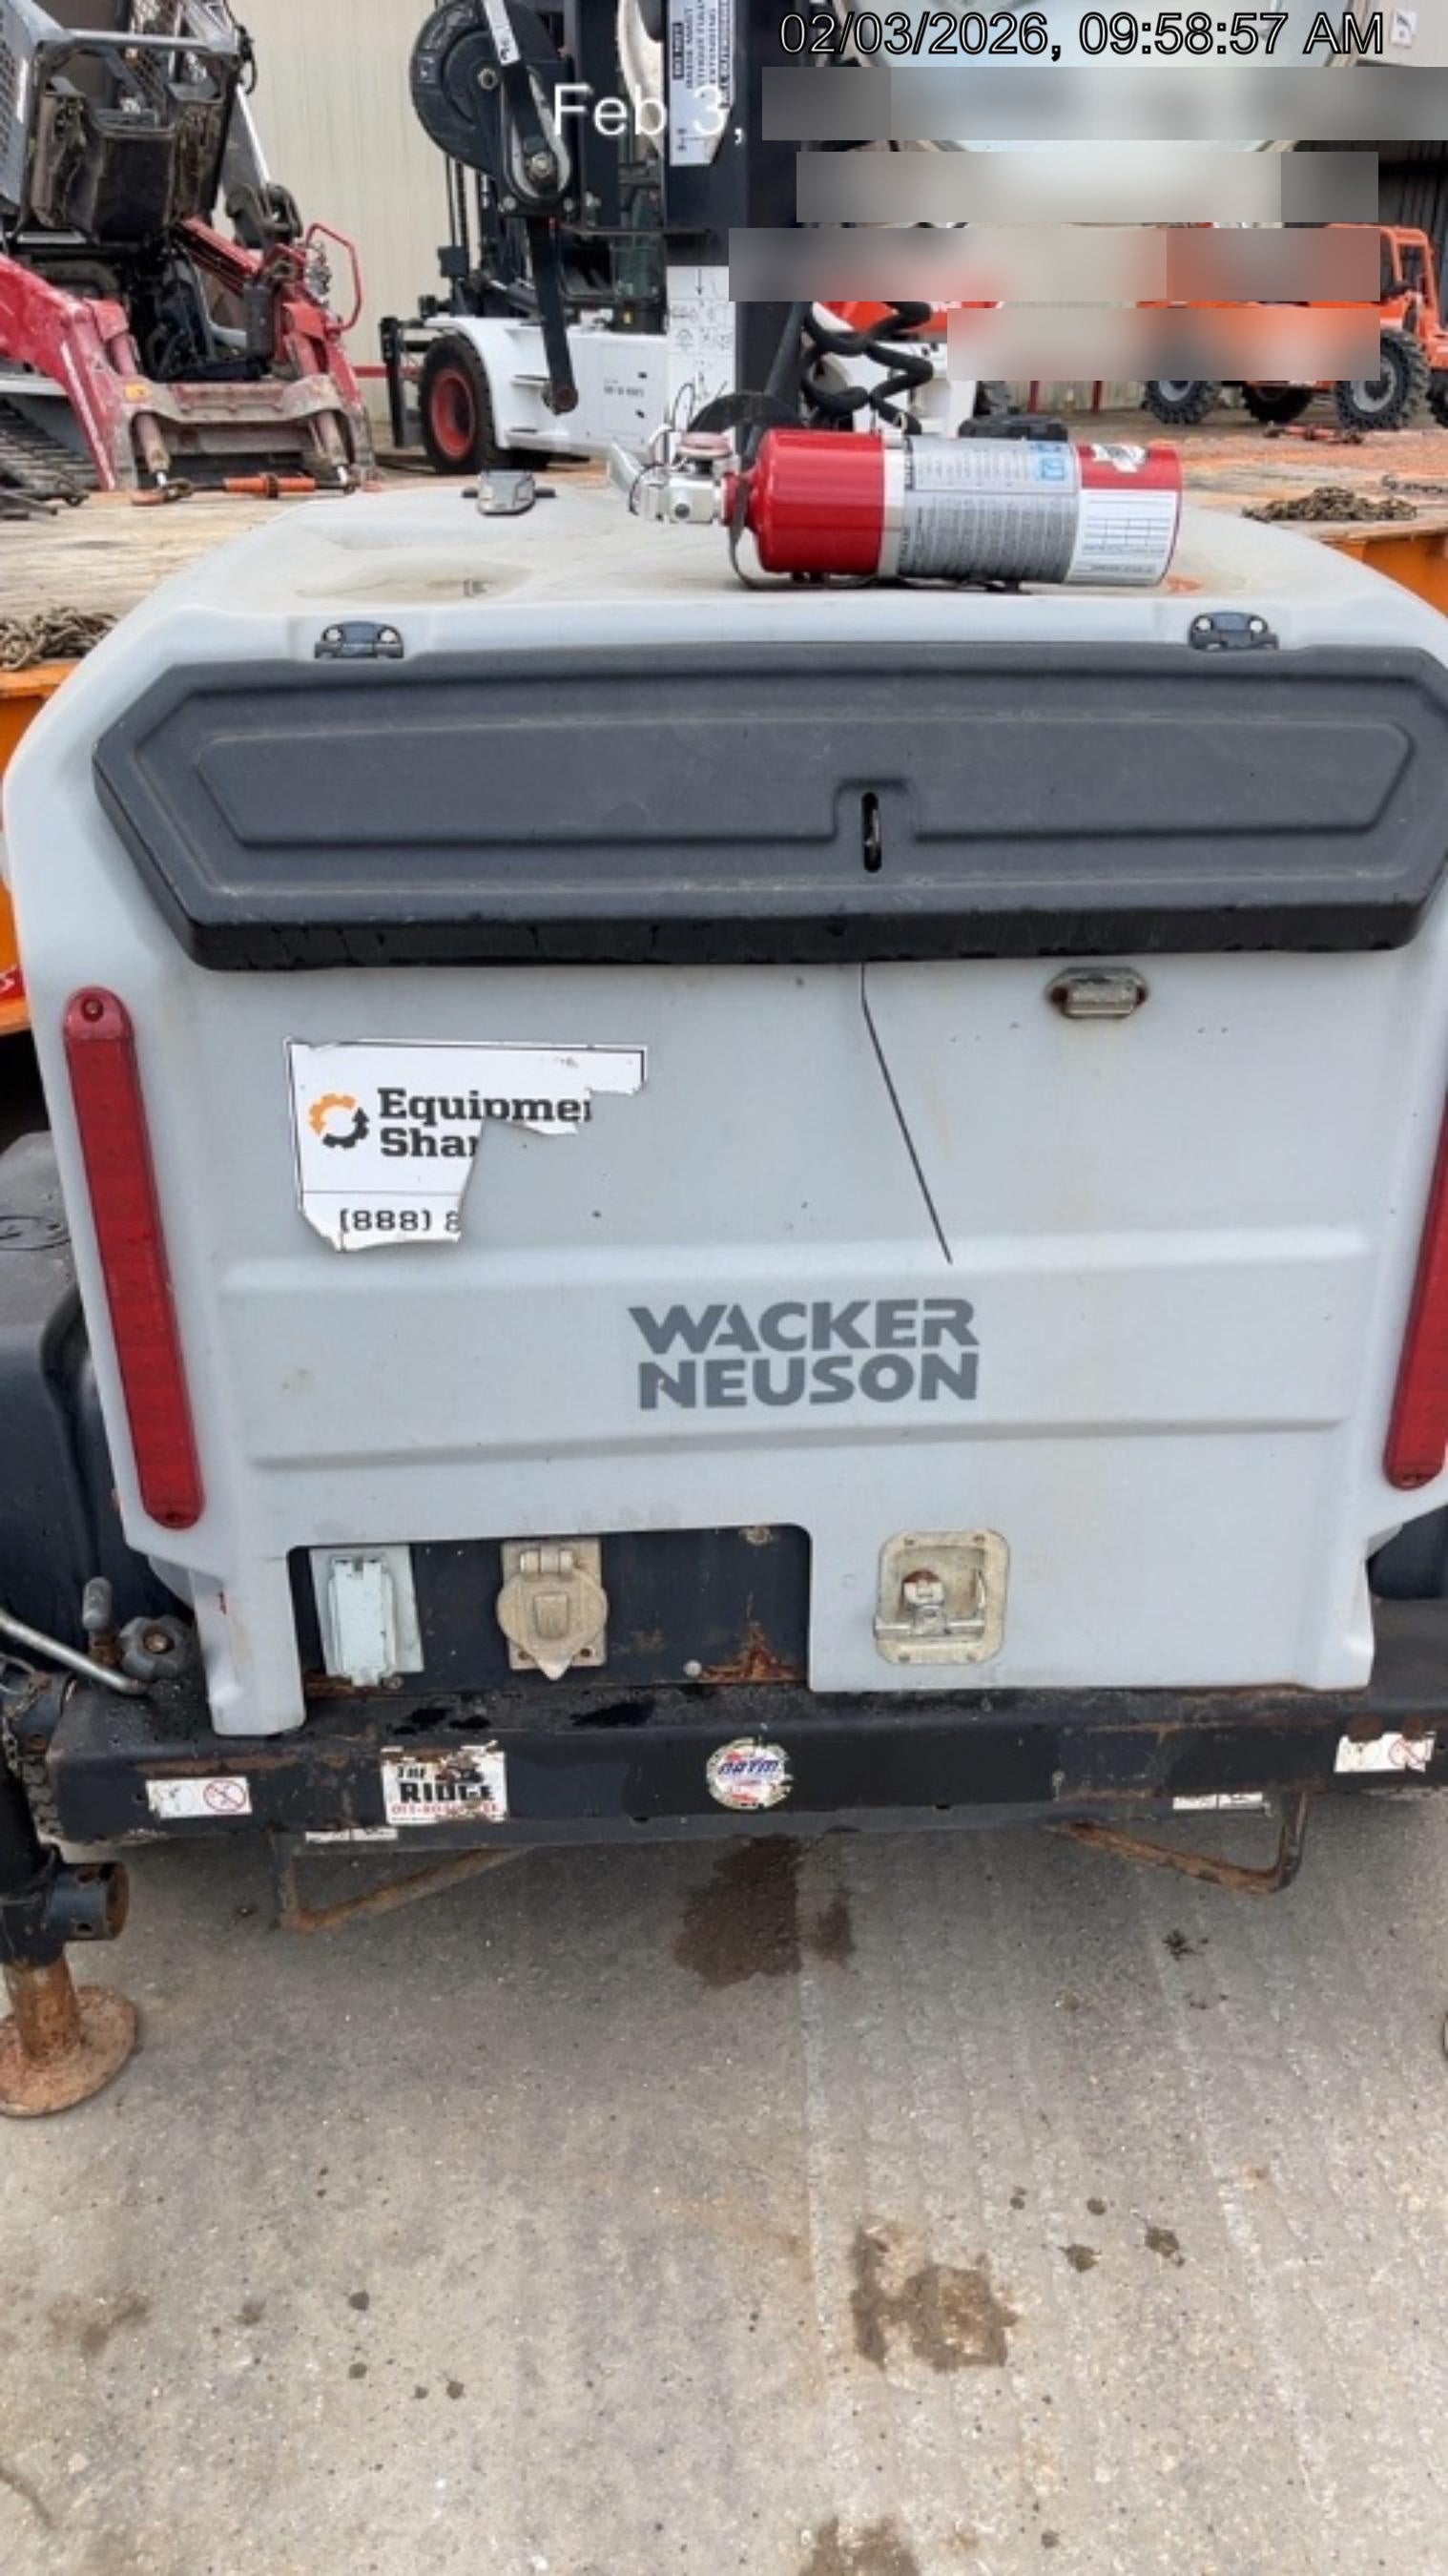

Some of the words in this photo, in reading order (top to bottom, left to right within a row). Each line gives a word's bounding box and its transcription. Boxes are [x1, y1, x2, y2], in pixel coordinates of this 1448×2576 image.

[340, 1209, 430, 1233] (888)
[628, 1298, 980, 1355] WACKER
[639, 1352, 979, 1409] NEUSON
